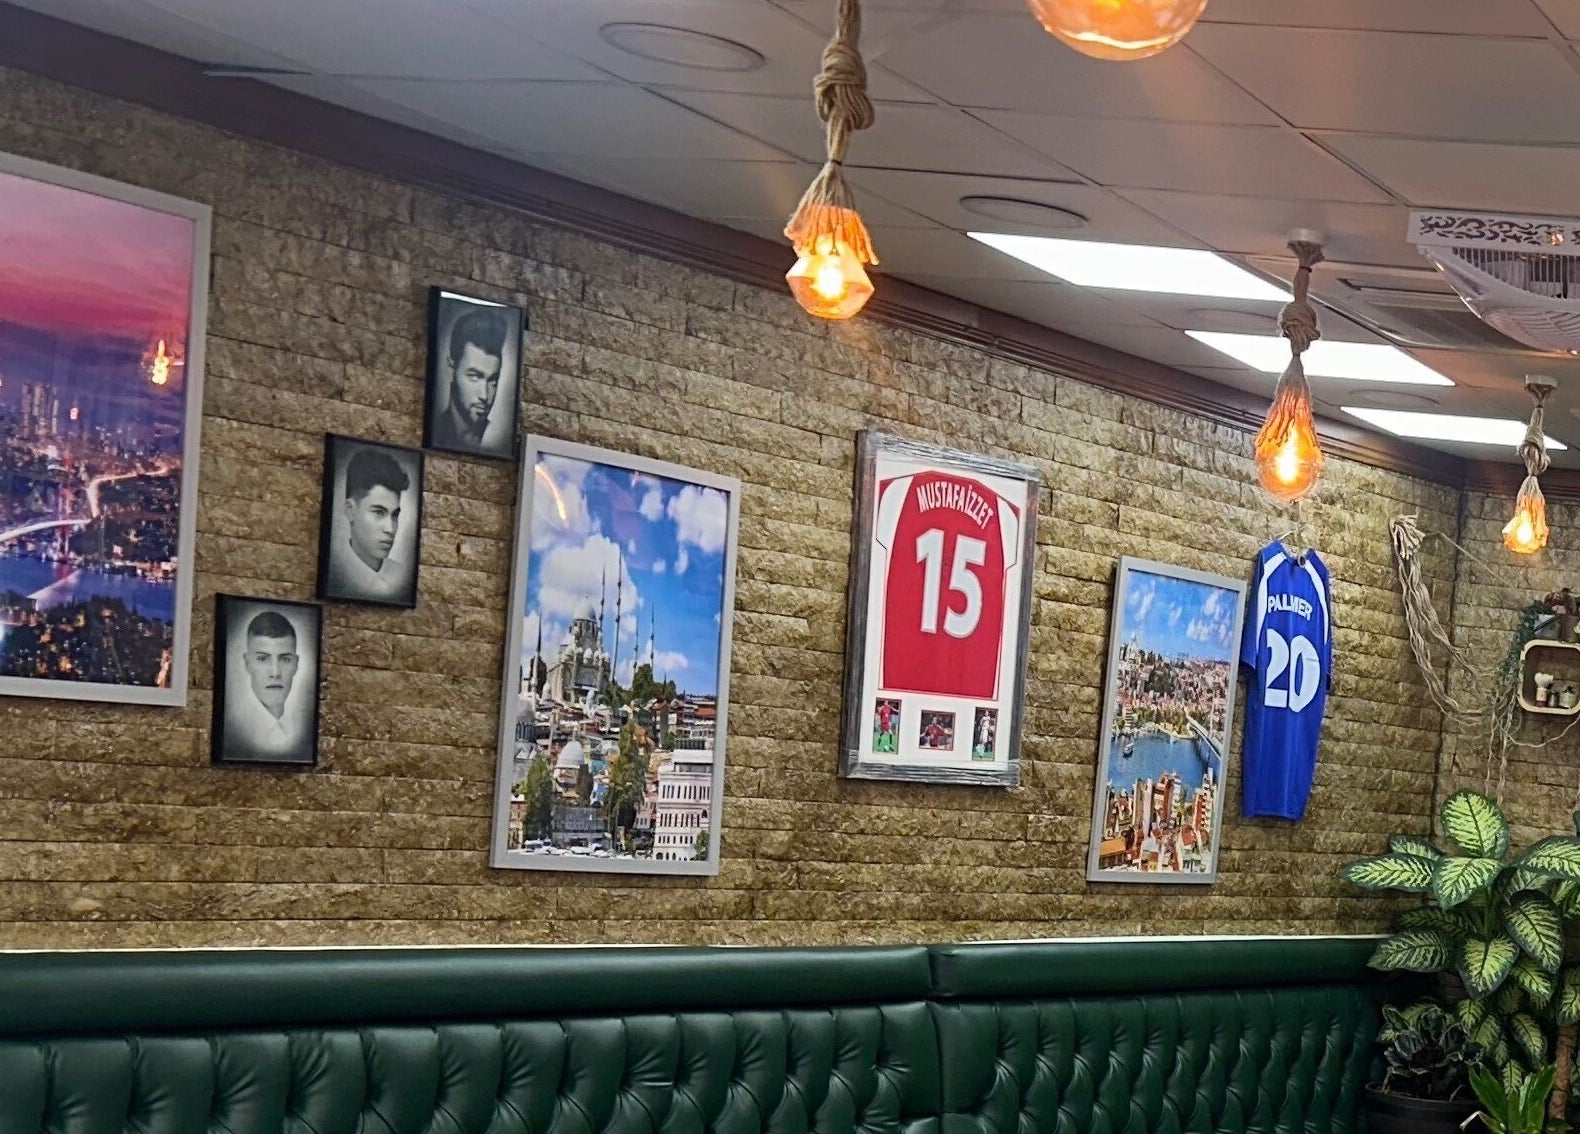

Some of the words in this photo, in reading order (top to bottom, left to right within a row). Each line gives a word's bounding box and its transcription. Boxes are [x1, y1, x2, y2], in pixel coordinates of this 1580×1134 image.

[916, 528, 987, 639] 15
[1267, 593, 1313, 621] PALMER
[1264, 628, 1321, 712] 20
